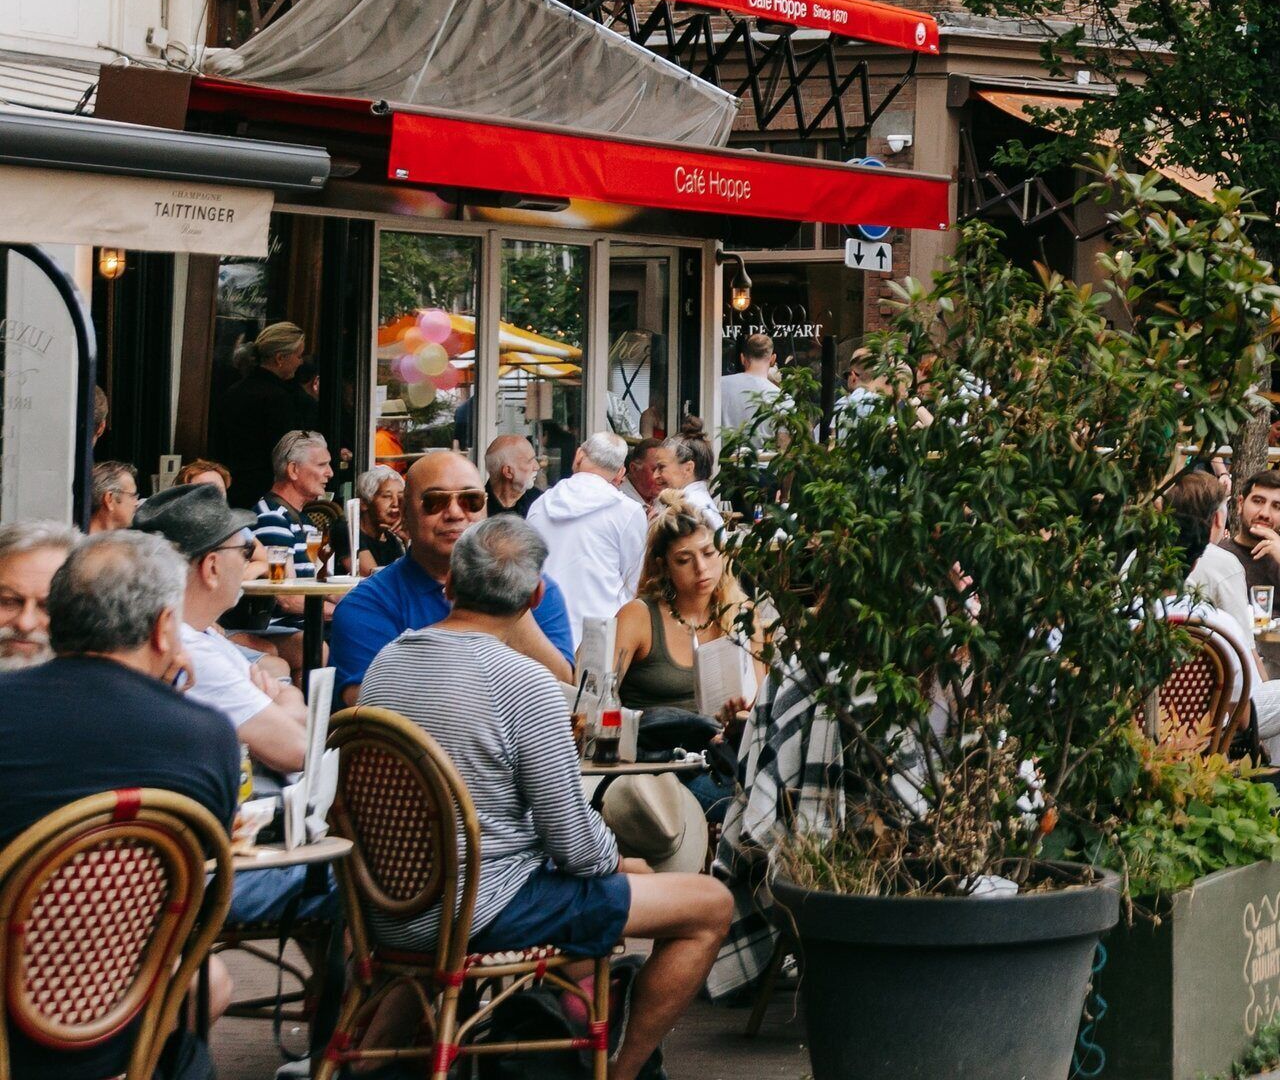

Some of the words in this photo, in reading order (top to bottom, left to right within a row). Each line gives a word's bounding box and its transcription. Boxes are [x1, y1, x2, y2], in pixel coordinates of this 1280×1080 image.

[813, 3, 832, 20] Since
[832, 9, 849, 25] 1670
[674, 165, 706, 195] Café
[709, 171, 752, 201] Hoppe
[172, 190, 223, 202] CHAMPAGNE
[154, 201, 236, 223] TAITTINGER
[773, 324, 823, 338] ZWART
